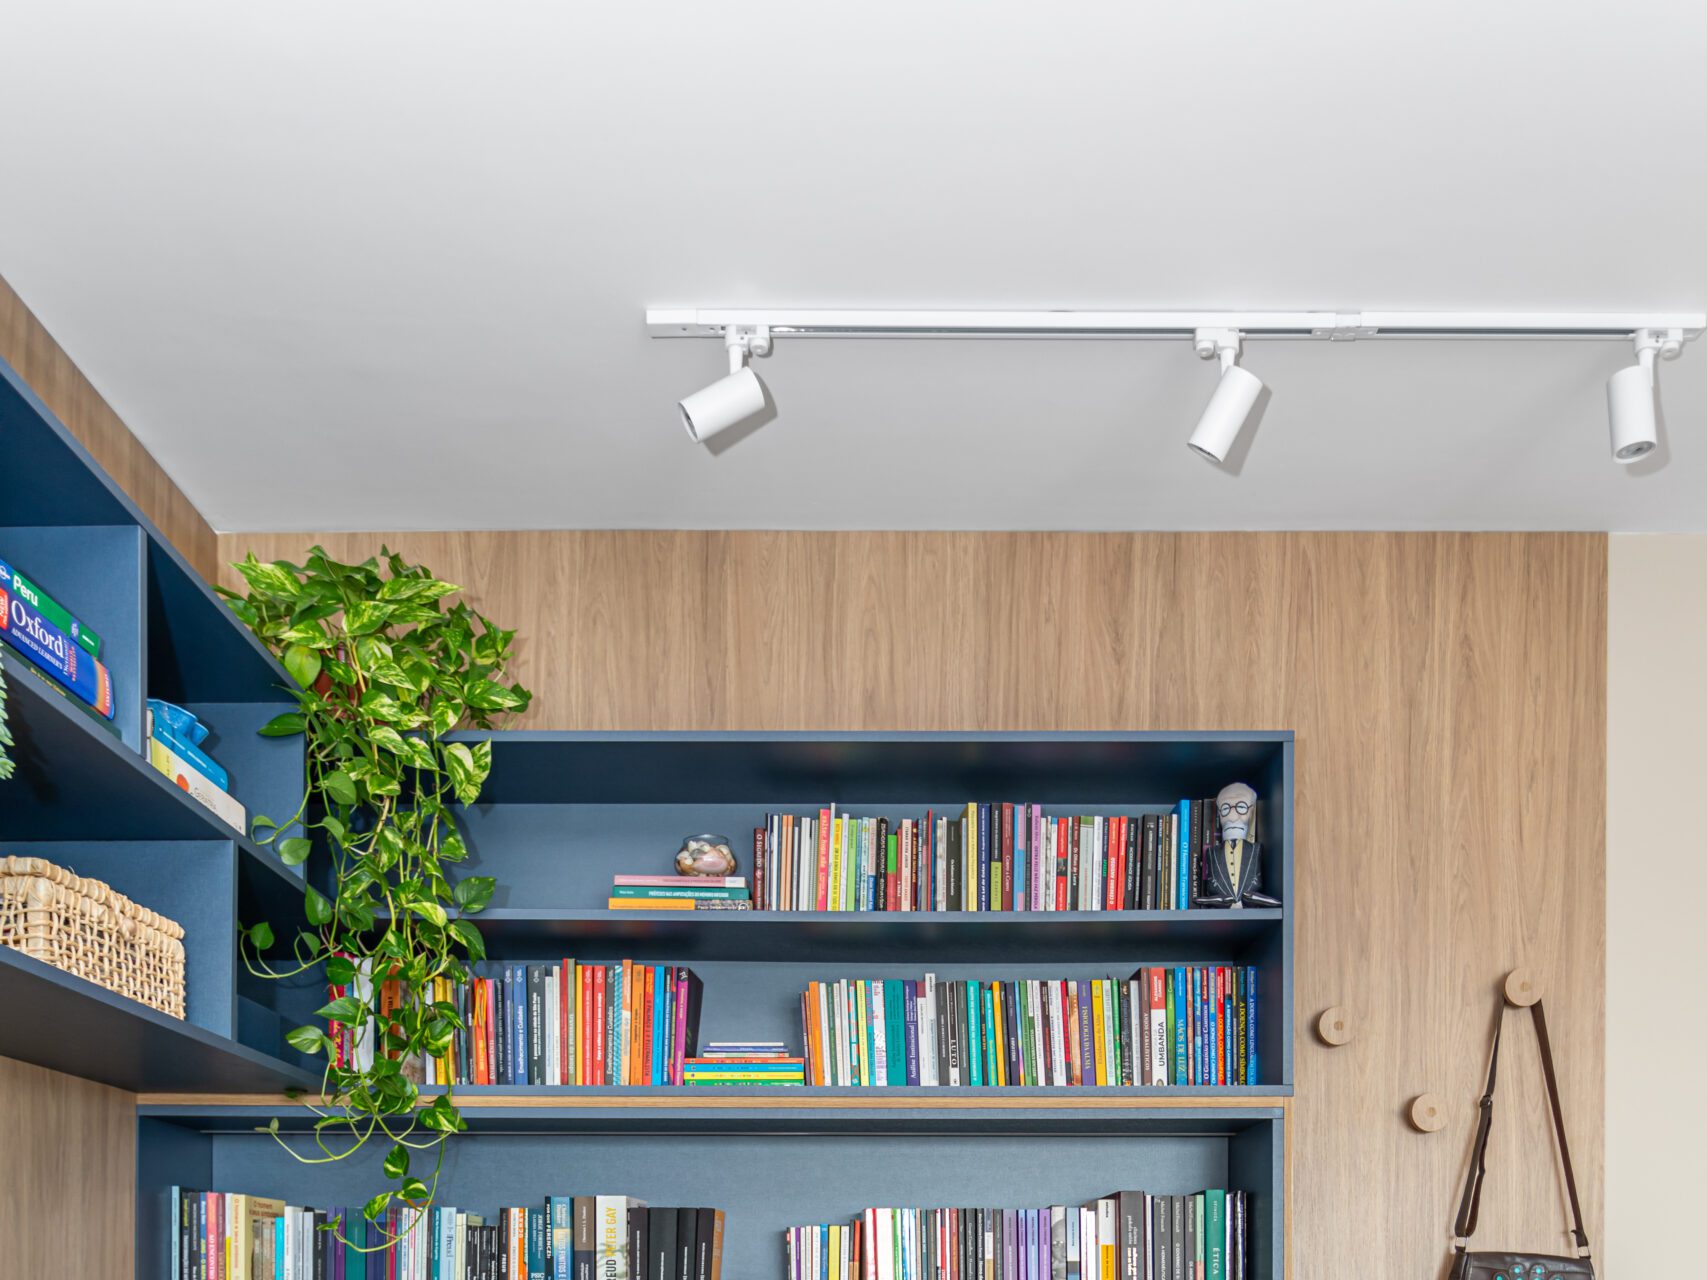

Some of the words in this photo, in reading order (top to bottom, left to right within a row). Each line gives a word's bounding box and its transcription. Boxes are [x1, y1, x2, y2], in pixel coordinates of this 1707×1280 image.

[13, 575, 38, 606] Peru
[12, 600, 65, 658] Oxford
[12, 628, 39, 653] ADVANCED
[1177, 1019, 1186, 1042] MÃOS
[606, 1207, 617, 1224] GAY
[446, 1235, 454, 1258] Freud
[606, 1228, 617, 1257] PETER
[558, 1251, 566, 1273] FINITOS
